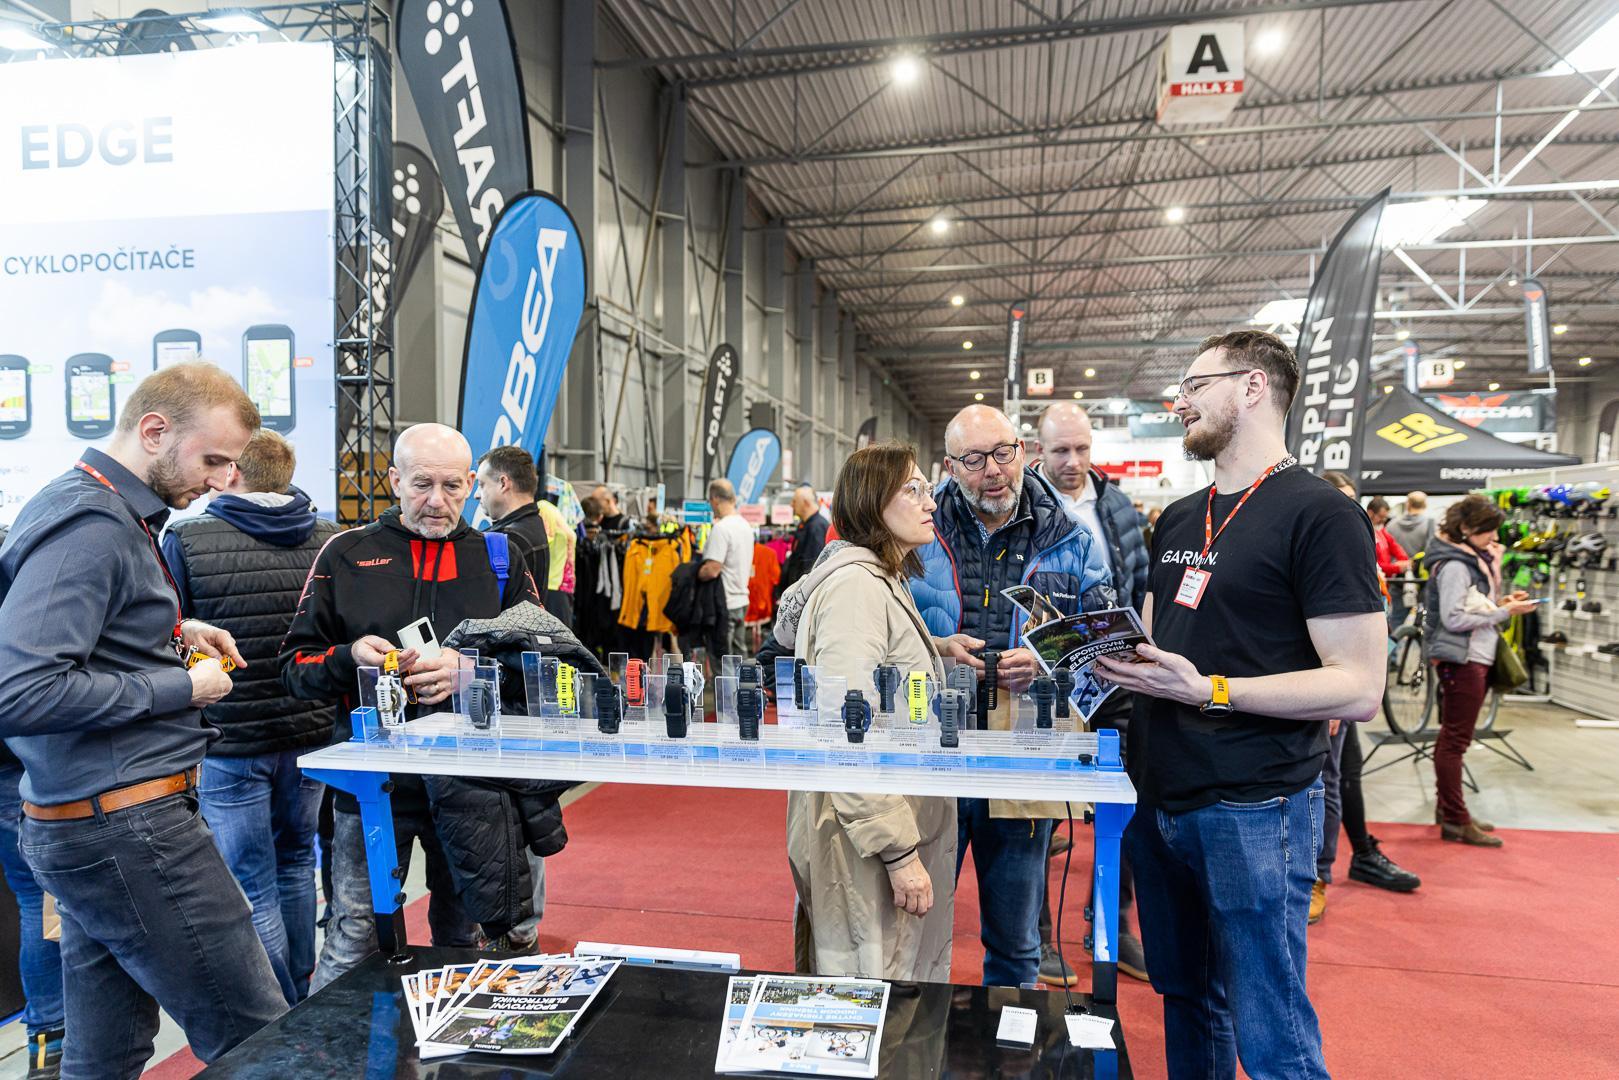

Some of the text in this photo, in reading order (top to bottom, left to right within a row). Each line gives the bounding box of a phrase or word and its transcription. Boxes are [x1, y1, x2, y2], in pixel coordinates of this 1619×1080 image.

[1186, 35, 1229, 73] A
[1180, 80, 1235, 95] HALA 2
[21, 115, 174, 170] EDGE
[4, 244, 196, 276] CYKLOPOČÍTAČE
[1035, 372, 1047, 384] B
[1433, 363, 1445, 376] B
[1300, 316, 1335, 472] RPHIN
[705, 371, 728, 458] CRAFT
[1324, 356, 1360, 470] BLIC
[1068, 644, 1134, 673] ELEKTRONIKA
[491, 995, 569, 1005] ELEKTRONIKA
